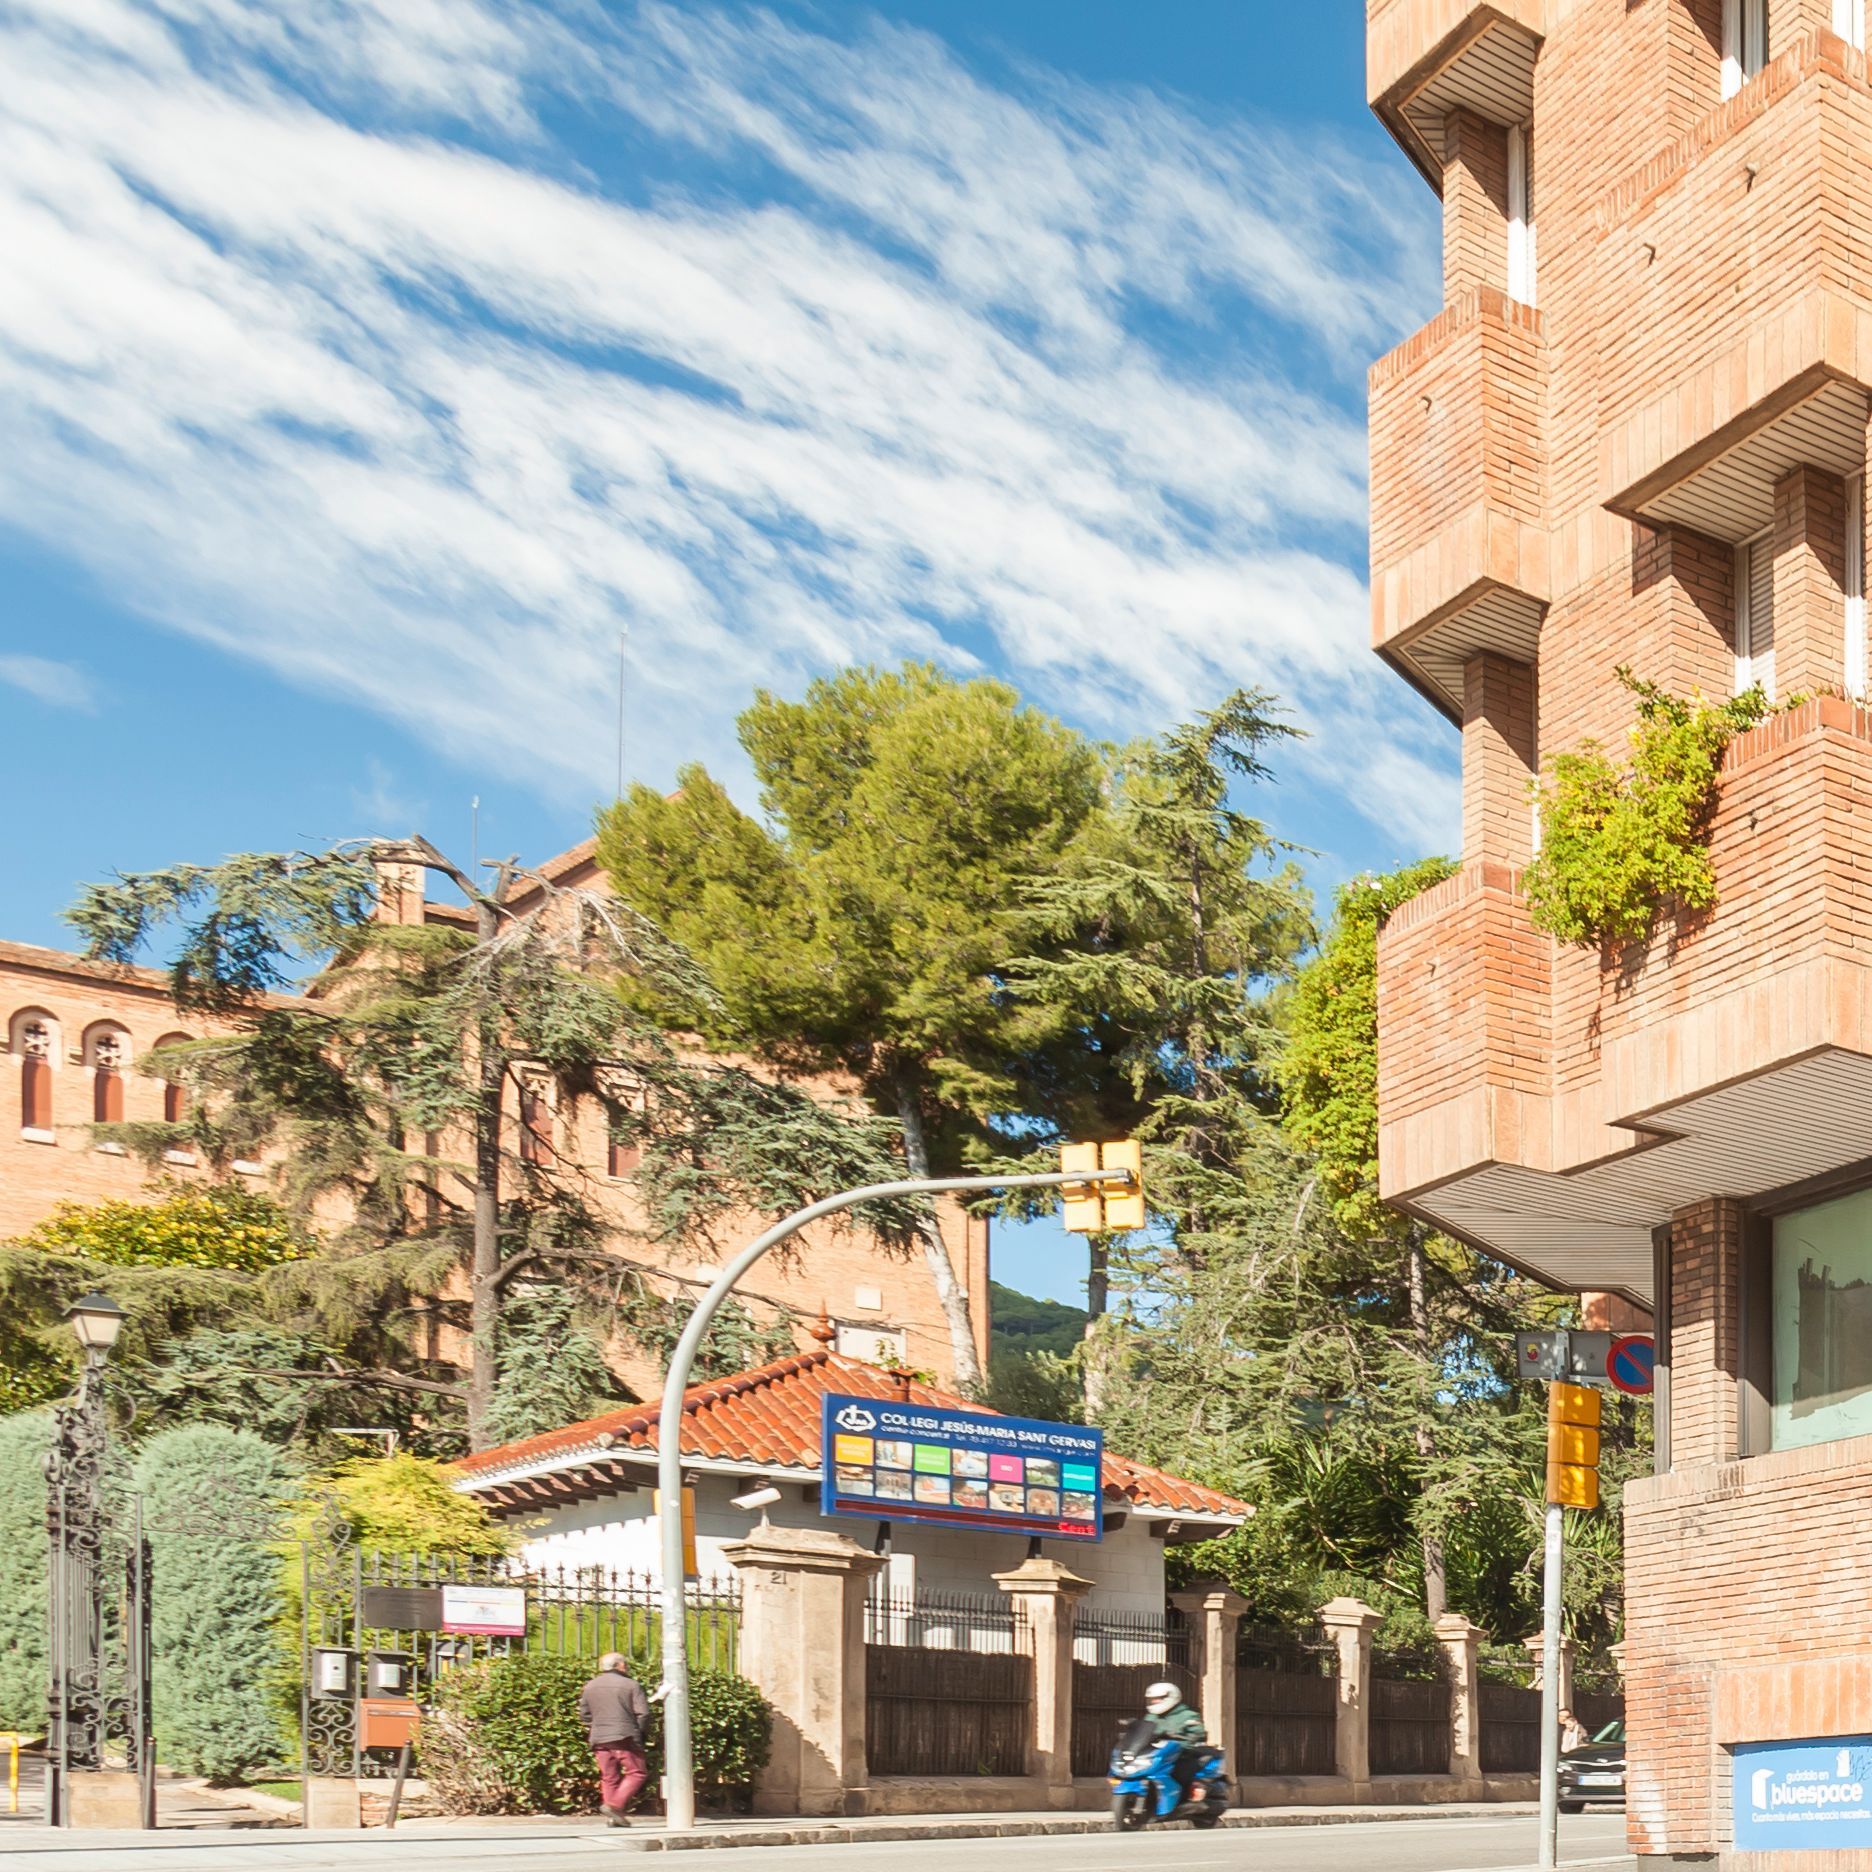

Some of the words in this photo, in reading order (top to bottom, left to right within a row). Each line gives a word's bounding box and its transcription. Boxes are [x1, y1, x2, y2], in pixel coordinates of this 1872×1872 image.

[1017, 1430, 1047, 1443] SANT
[1049, 1434, 1096, 1450] GERVASI
[771, 1571, 787, 1585] 21
[1818, 1770, 1830, 1781] en
[1771, 1782, 1864, 1809] bluespace
